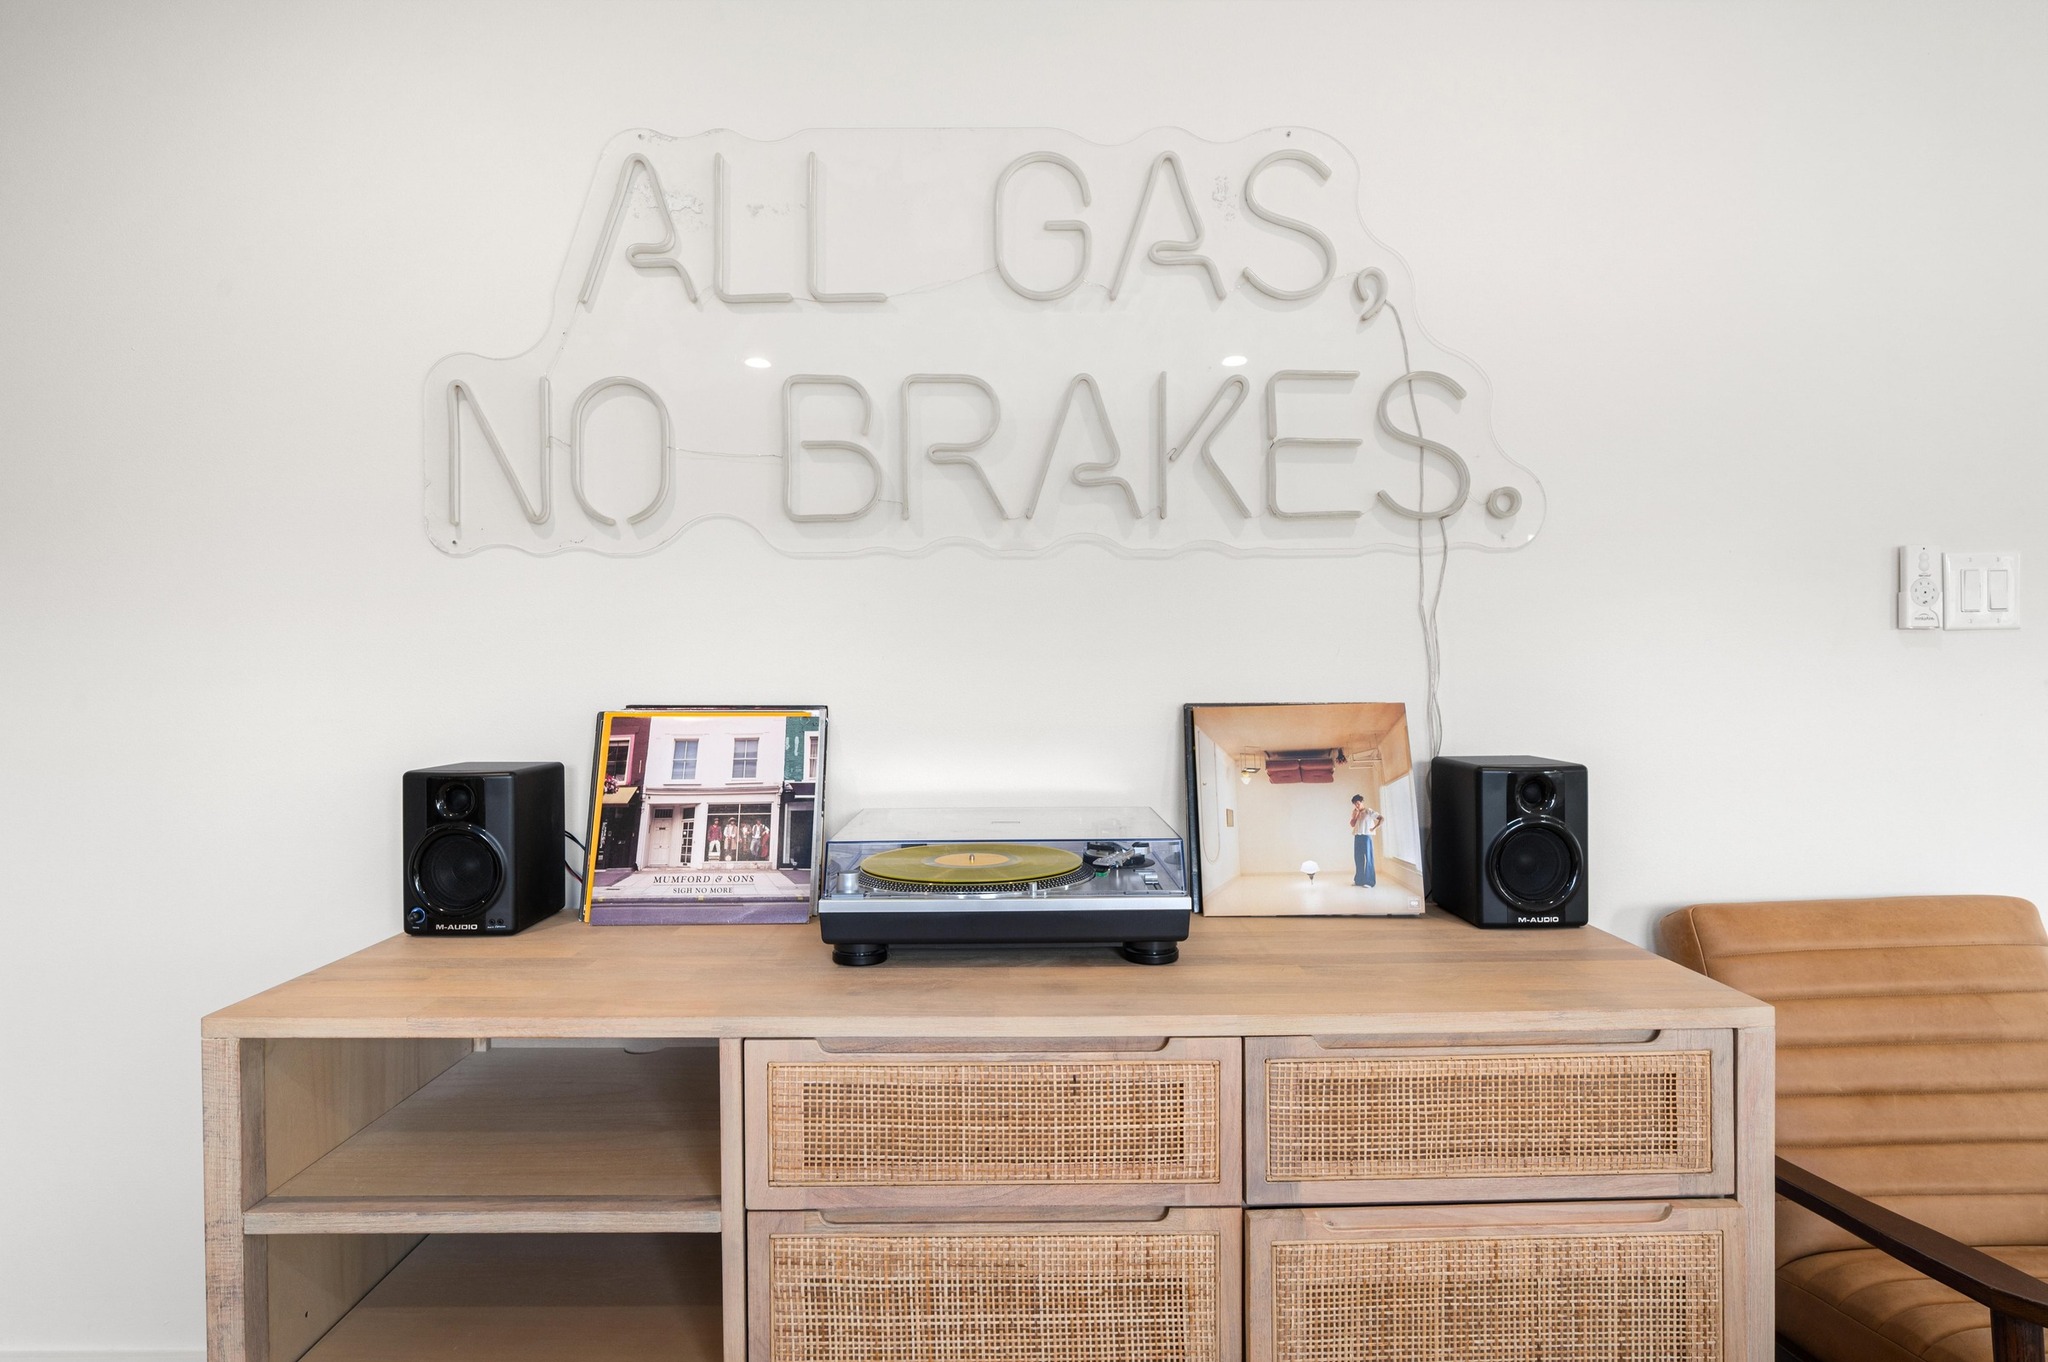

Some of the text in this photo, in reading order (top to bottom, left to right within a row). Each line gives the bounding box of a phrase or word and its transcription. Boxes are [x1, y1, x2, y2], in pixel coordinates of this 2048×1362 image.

[578, 149, 1389, 322] ALL GAS,
[446, 370, 1523, 527] NO BRAKES.
[653, 875, 755, 884] MUMFORD & SONS
